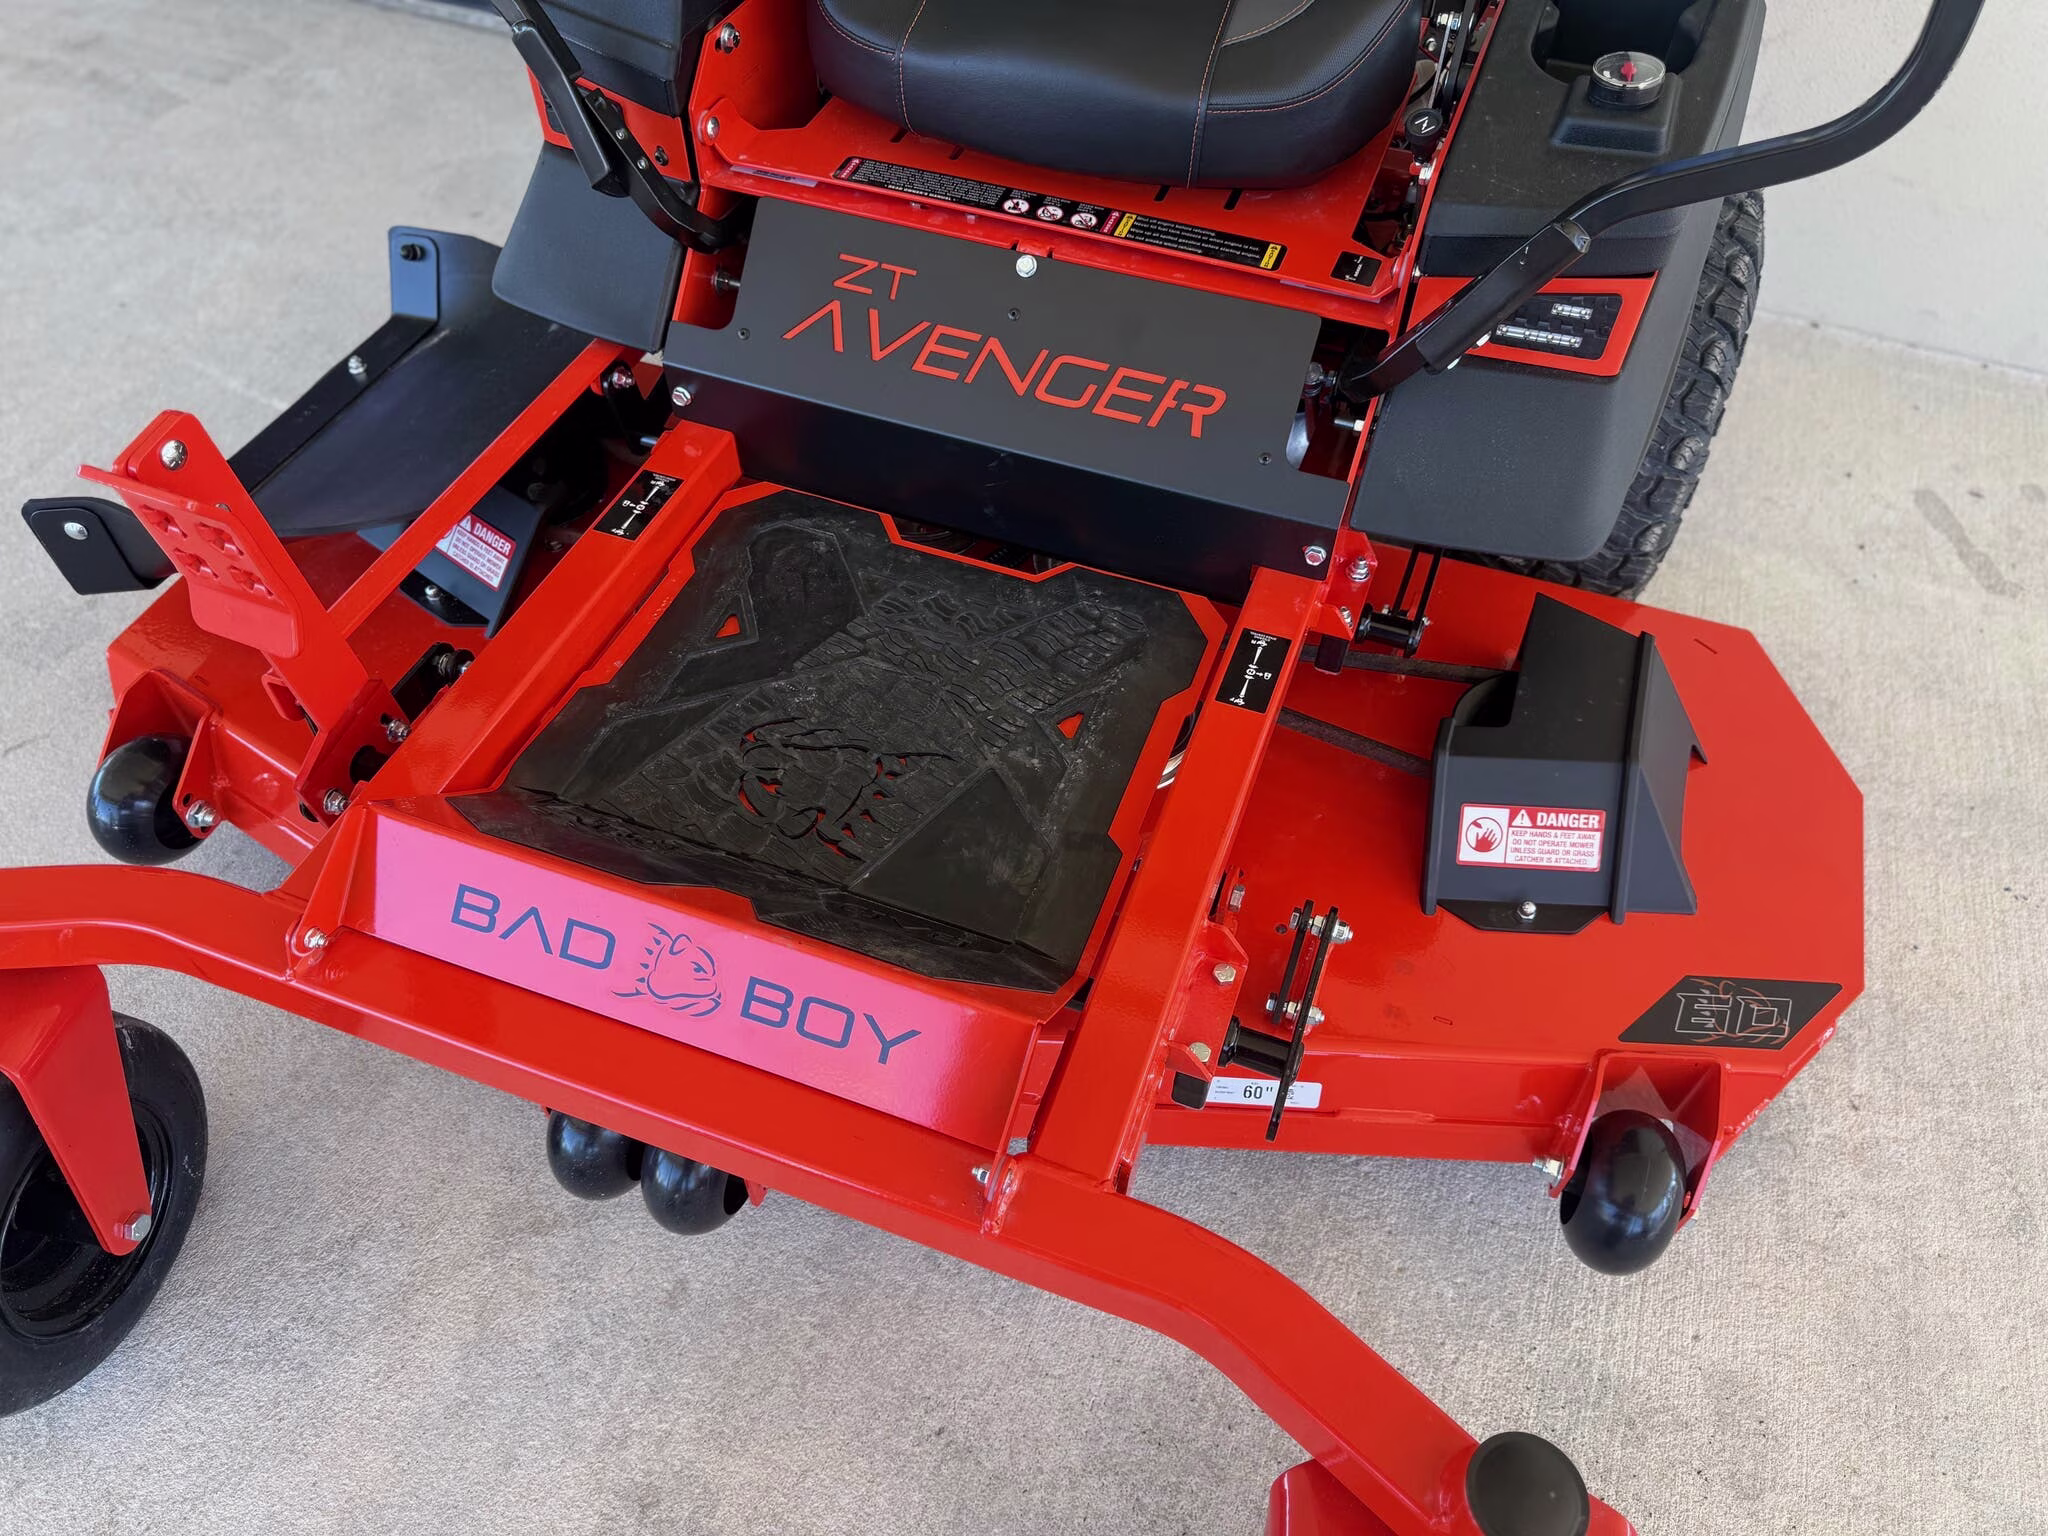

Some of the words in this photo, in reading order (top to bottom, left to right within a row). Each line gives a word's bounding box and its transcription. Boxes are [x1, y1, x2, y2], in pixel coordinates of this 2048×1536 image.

[832, 253, 917, 301] ZT
[781, 300, 1227, 439] AVENGER
[474, 523, 511, 556] DANGER
[1536, 812, 1600, 828] DANGER
[450, 883, 616, 970] BAD
[739, 976, 922, 1065] BOY
[1243, 1085, 1273, 1099] 60"
